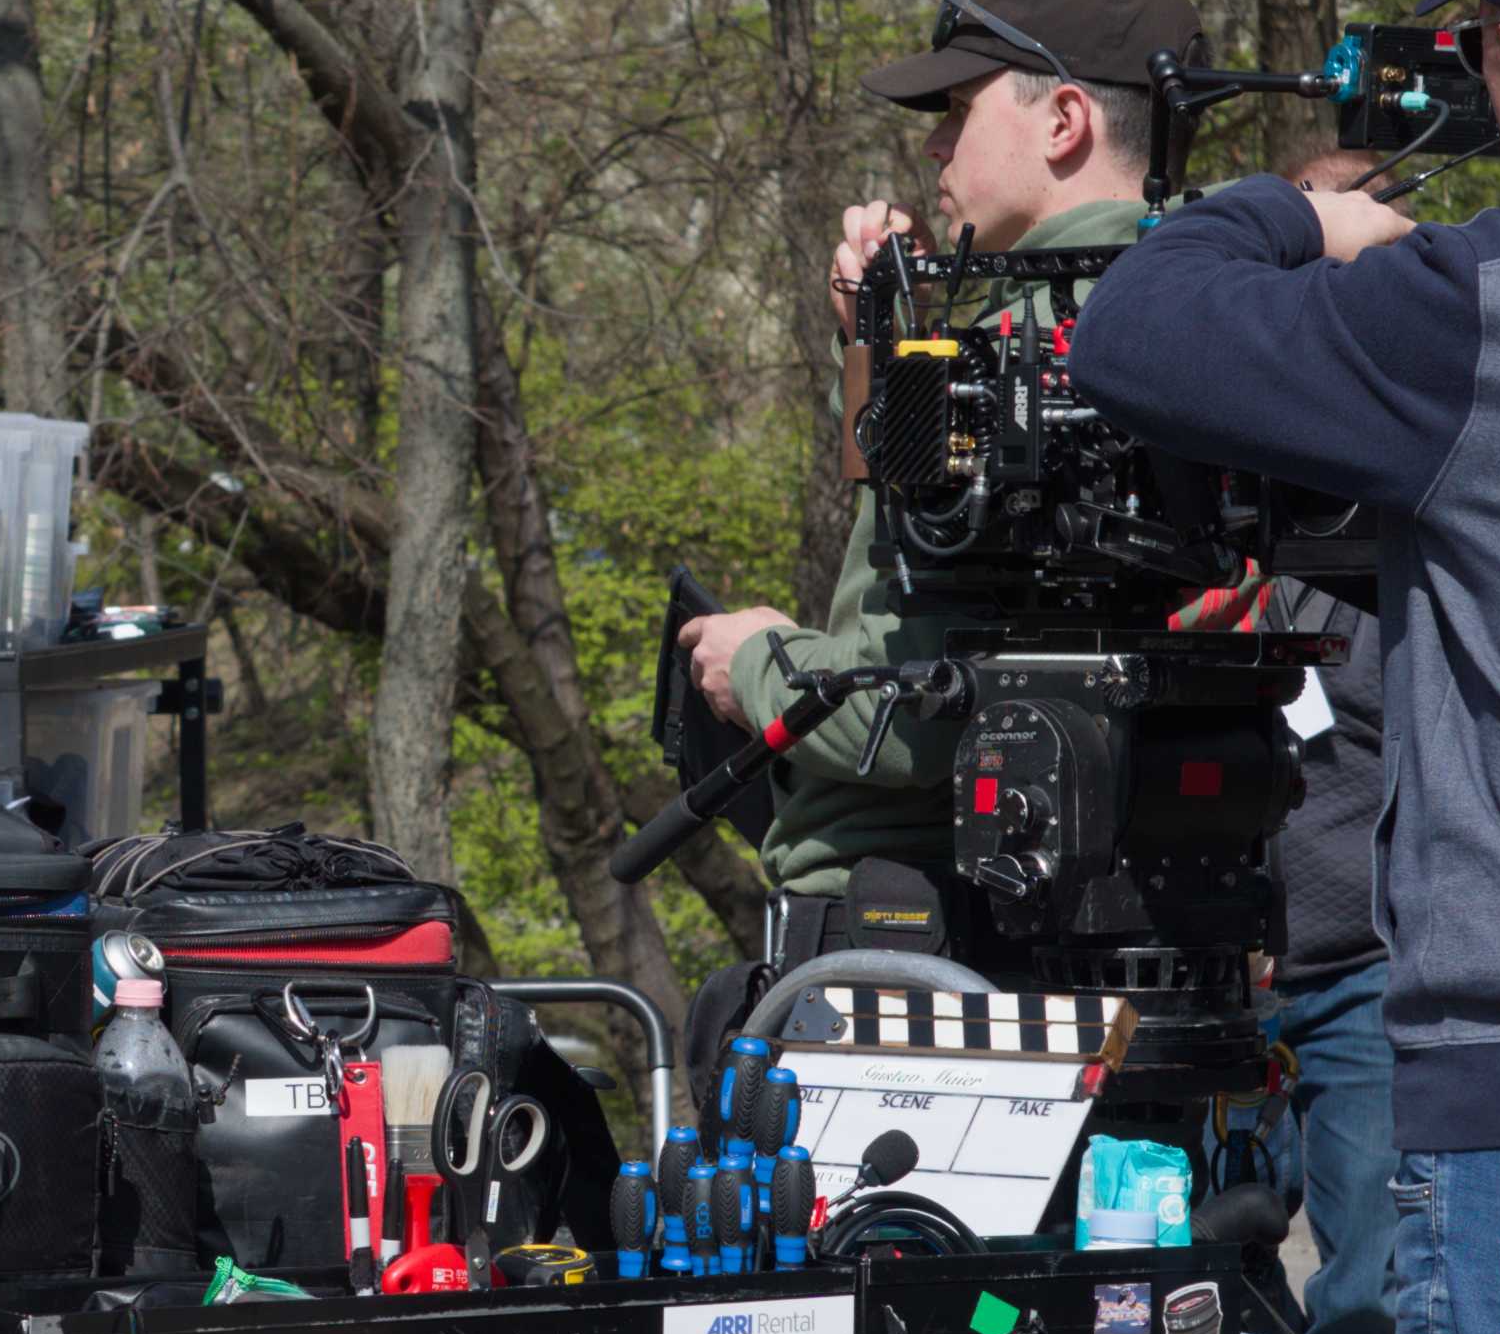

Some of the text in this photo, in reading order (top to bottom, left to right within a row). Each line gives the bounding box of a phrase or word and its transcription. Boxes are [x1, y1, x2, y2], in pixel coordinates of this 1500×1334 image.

[1014, 385, 1028, 431] ARRI
[285, 1083, 330, 1110] TB
[800, 1088, 824, 1104] OLL
[878, 1093, 935, 1110] SCENE
[1008, 1100, 1055, 1117] TAKE
[757, 1310, 815, 1334] Rental
